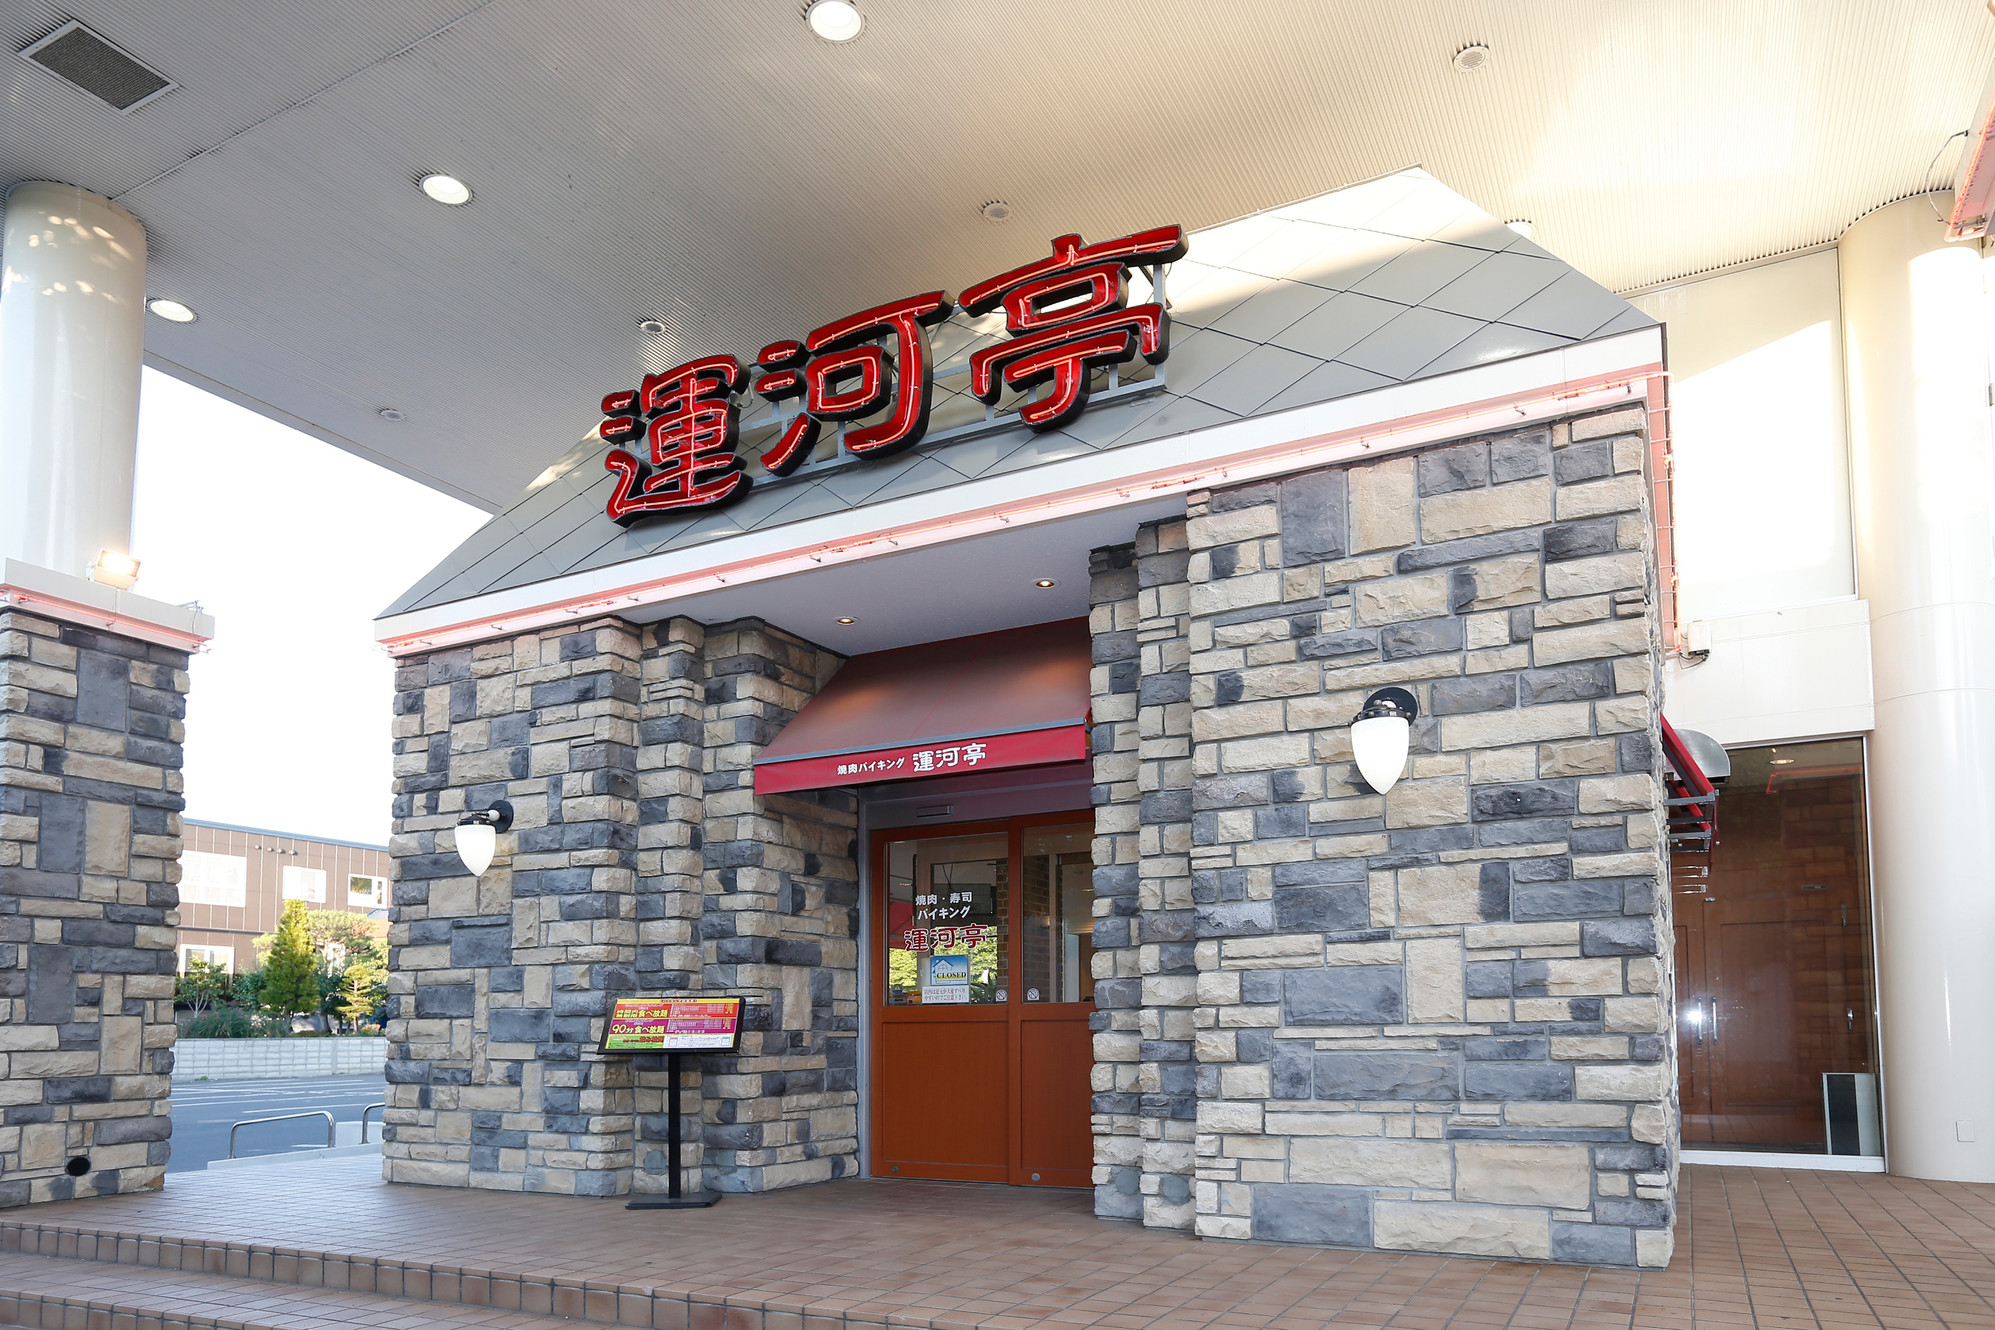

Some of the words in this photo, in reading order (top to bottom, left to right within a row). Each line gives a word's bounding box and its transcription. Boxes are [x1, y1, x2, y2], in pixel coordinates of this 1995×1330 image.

[601, 223, 1188, 527] 運河亭
[837, 757, 906, 776] 焼肉バイキング
[912, 742, 987, 773] 運河亭
[917, 905, 972, 921] バイキング
[903, 922, 989, 952] 運河亭
[936, 971, 967, 979] CLOSED
